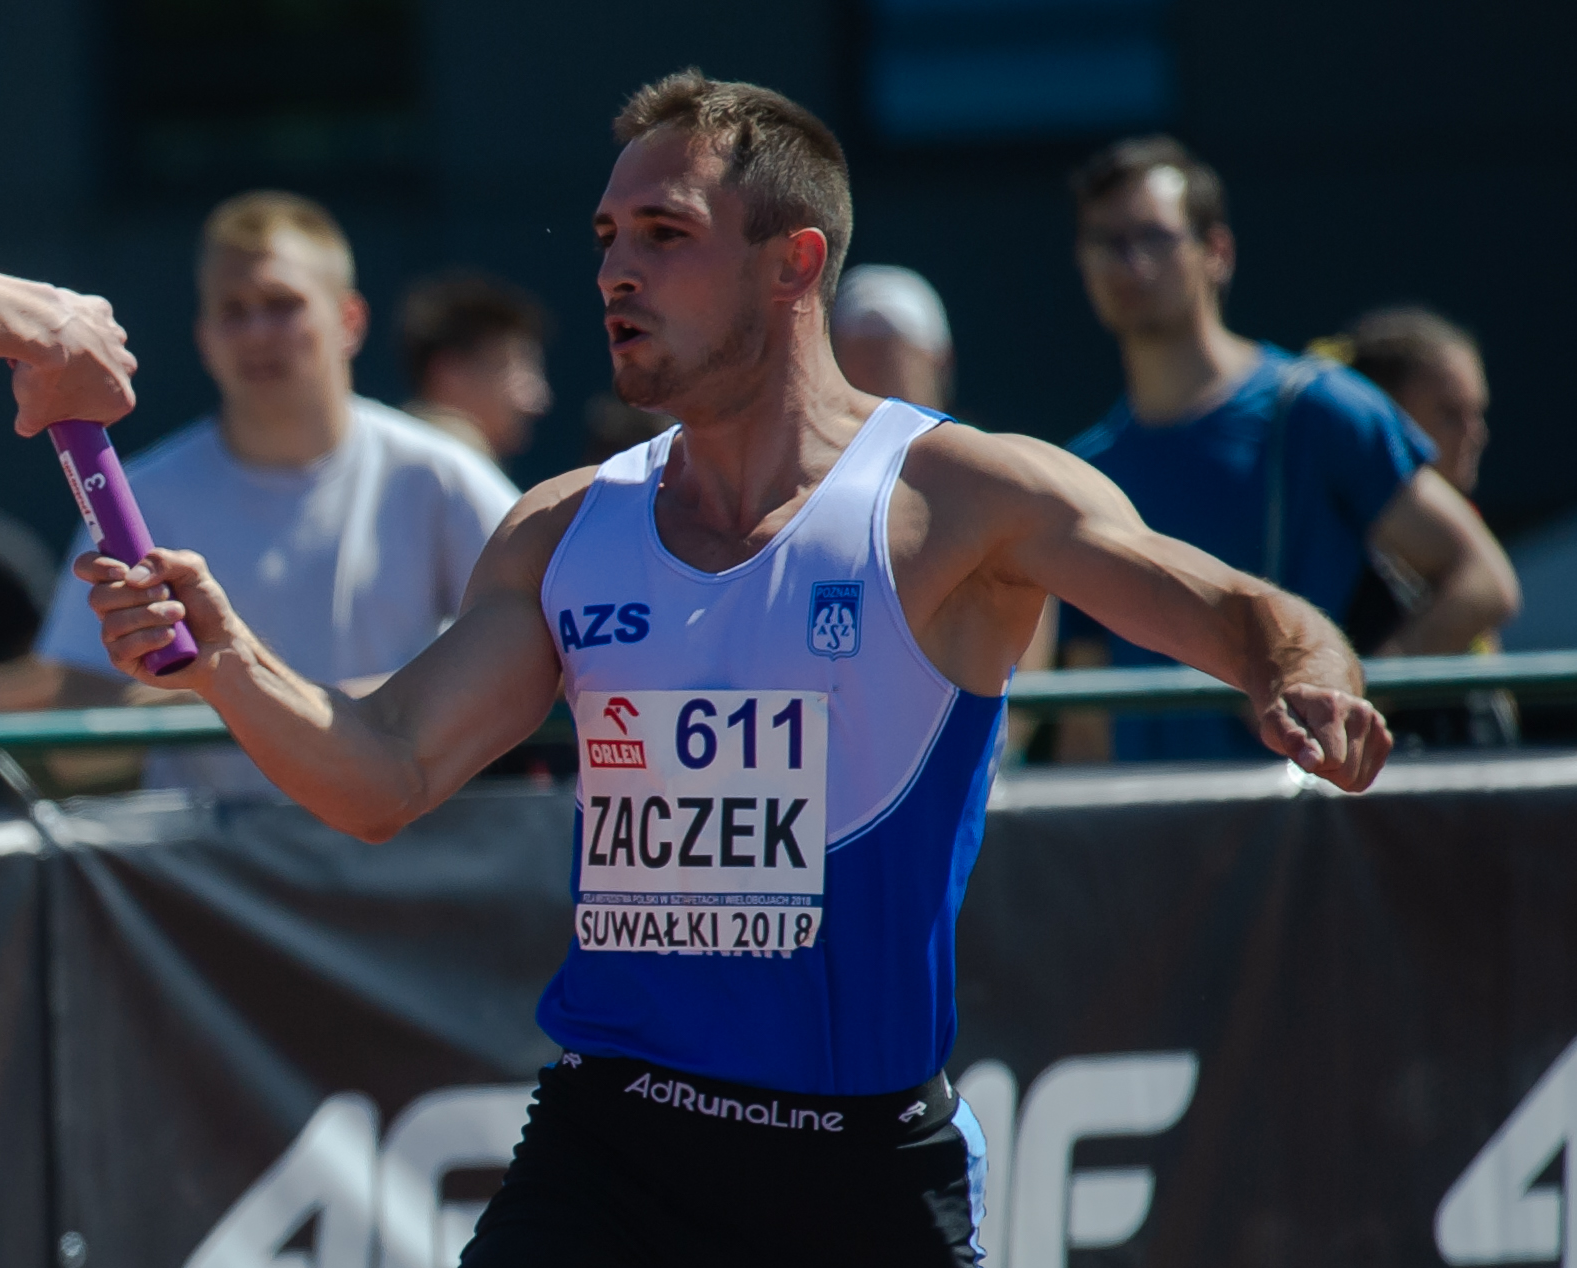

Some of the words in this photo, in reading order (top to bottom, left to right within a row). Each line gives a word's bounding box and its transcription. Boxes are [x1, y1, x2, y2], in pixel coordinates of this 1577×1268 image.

[559, 602, 651, 654] AZS
[589, 742, 644, 767] ORLEN
[675, 698, 804, 770] 611
[588, 796, 809, 869] ZACZEK
[581, 910, 719, 948] SUWAŁKI
[731, 912, 813, 948] 2018
[625, 1072, 823, 1132] AdRunaLine
